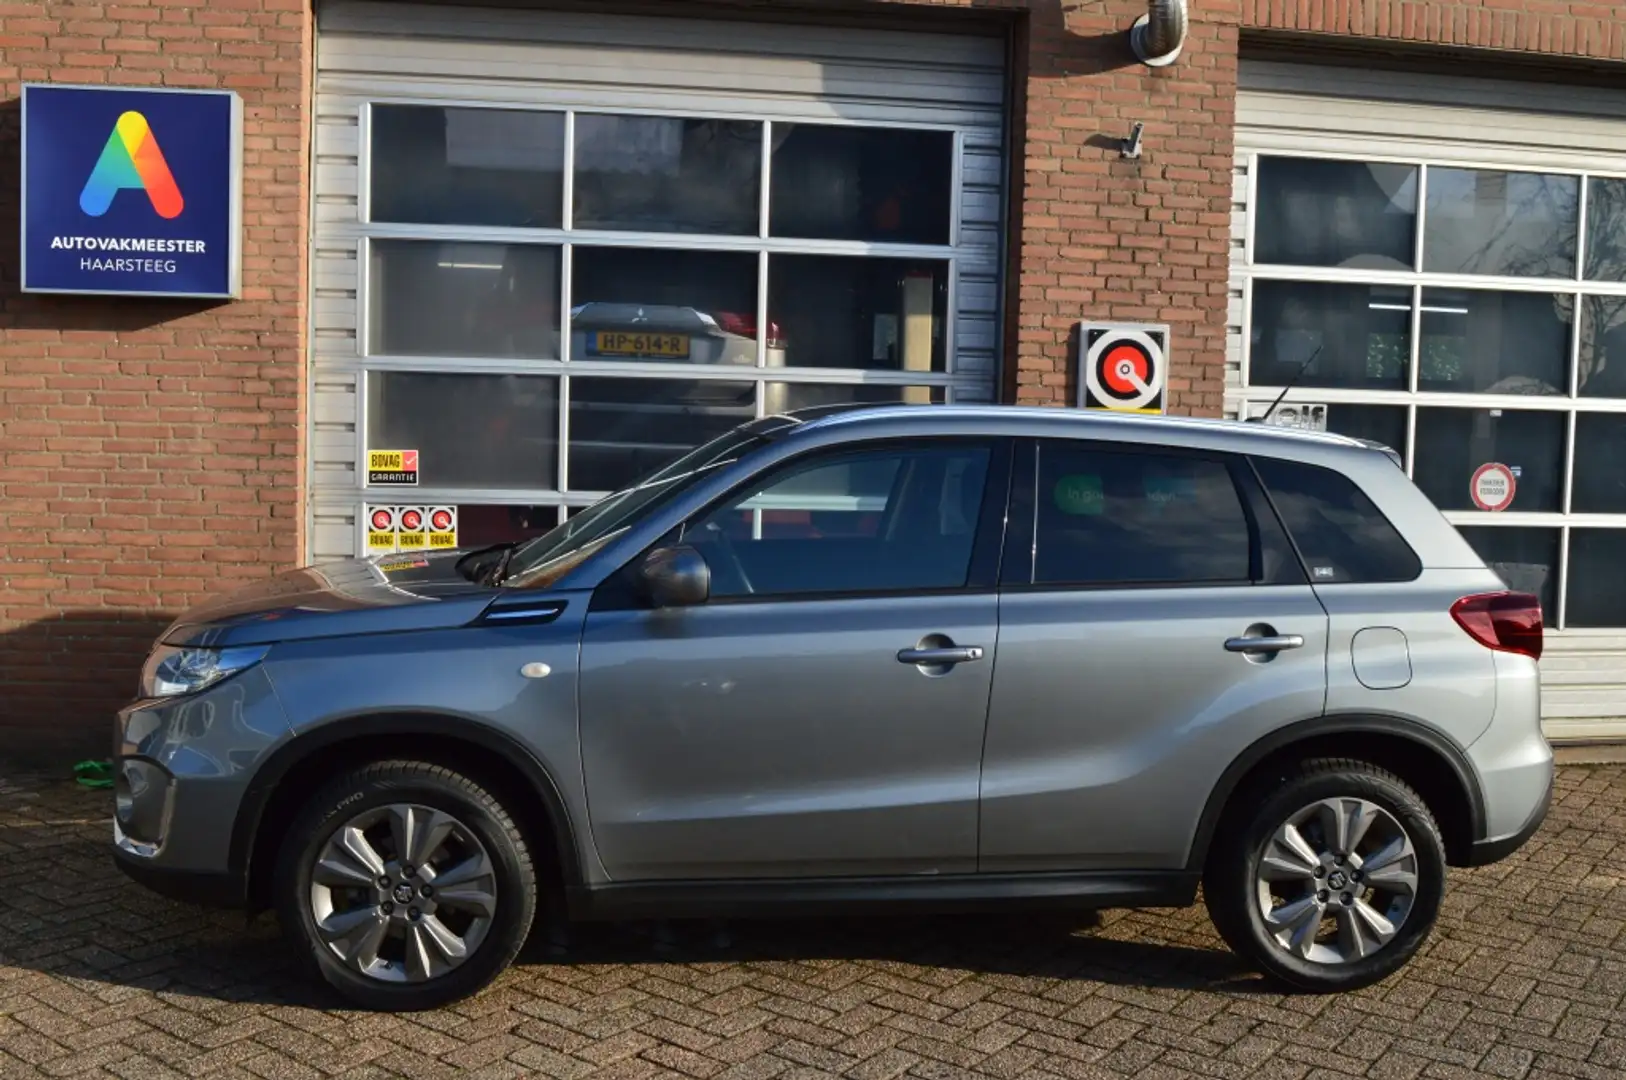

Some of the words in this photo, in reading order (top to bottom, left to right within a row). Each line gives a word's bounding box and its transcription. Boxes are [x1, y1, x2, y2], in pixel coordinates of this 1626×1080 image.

[50, 236, 206, 253] AUTOVAKMEESTER
[80, 257, 177, 273] HAARSTEEG
[603, 333, 681, 352] HP-614-R
[371, 454, 400, 468] BOVAG
[371, 472, 415, 481] GARANTIE
[370, 534, 393, 546] BOVAG
[400, 534, 424, 546] BOVAG
[430, 534, 454, 545] BOVAG
